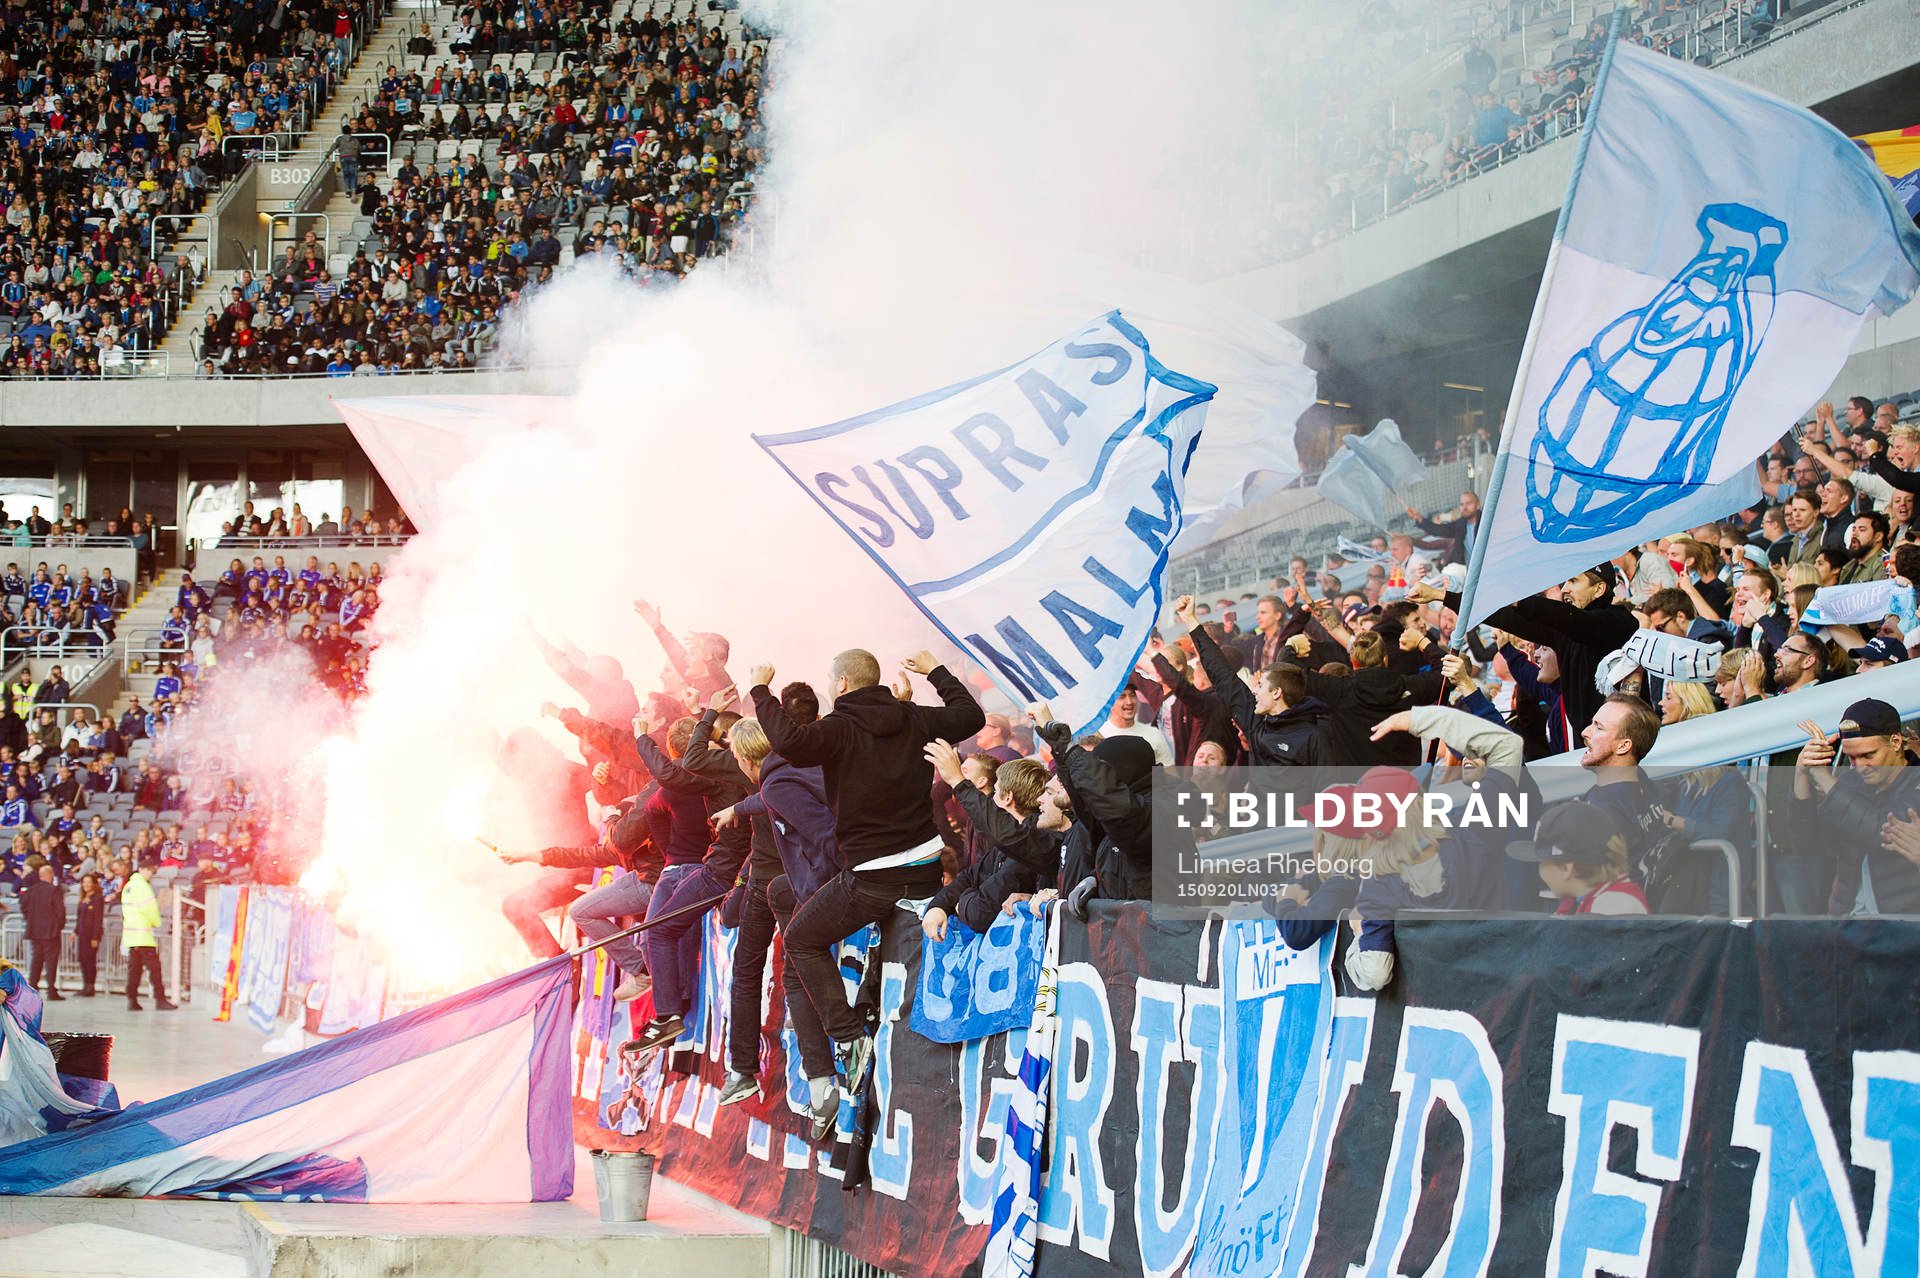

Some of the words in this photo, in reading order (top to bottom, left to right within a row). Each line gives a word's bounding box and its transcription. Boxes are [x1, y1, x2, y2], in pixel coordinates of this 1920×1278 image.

[270, 168, 311, 185] B303
[814, 327, 1133, 548] SUPRAS
[965, 470, 1178, 703] MALM
